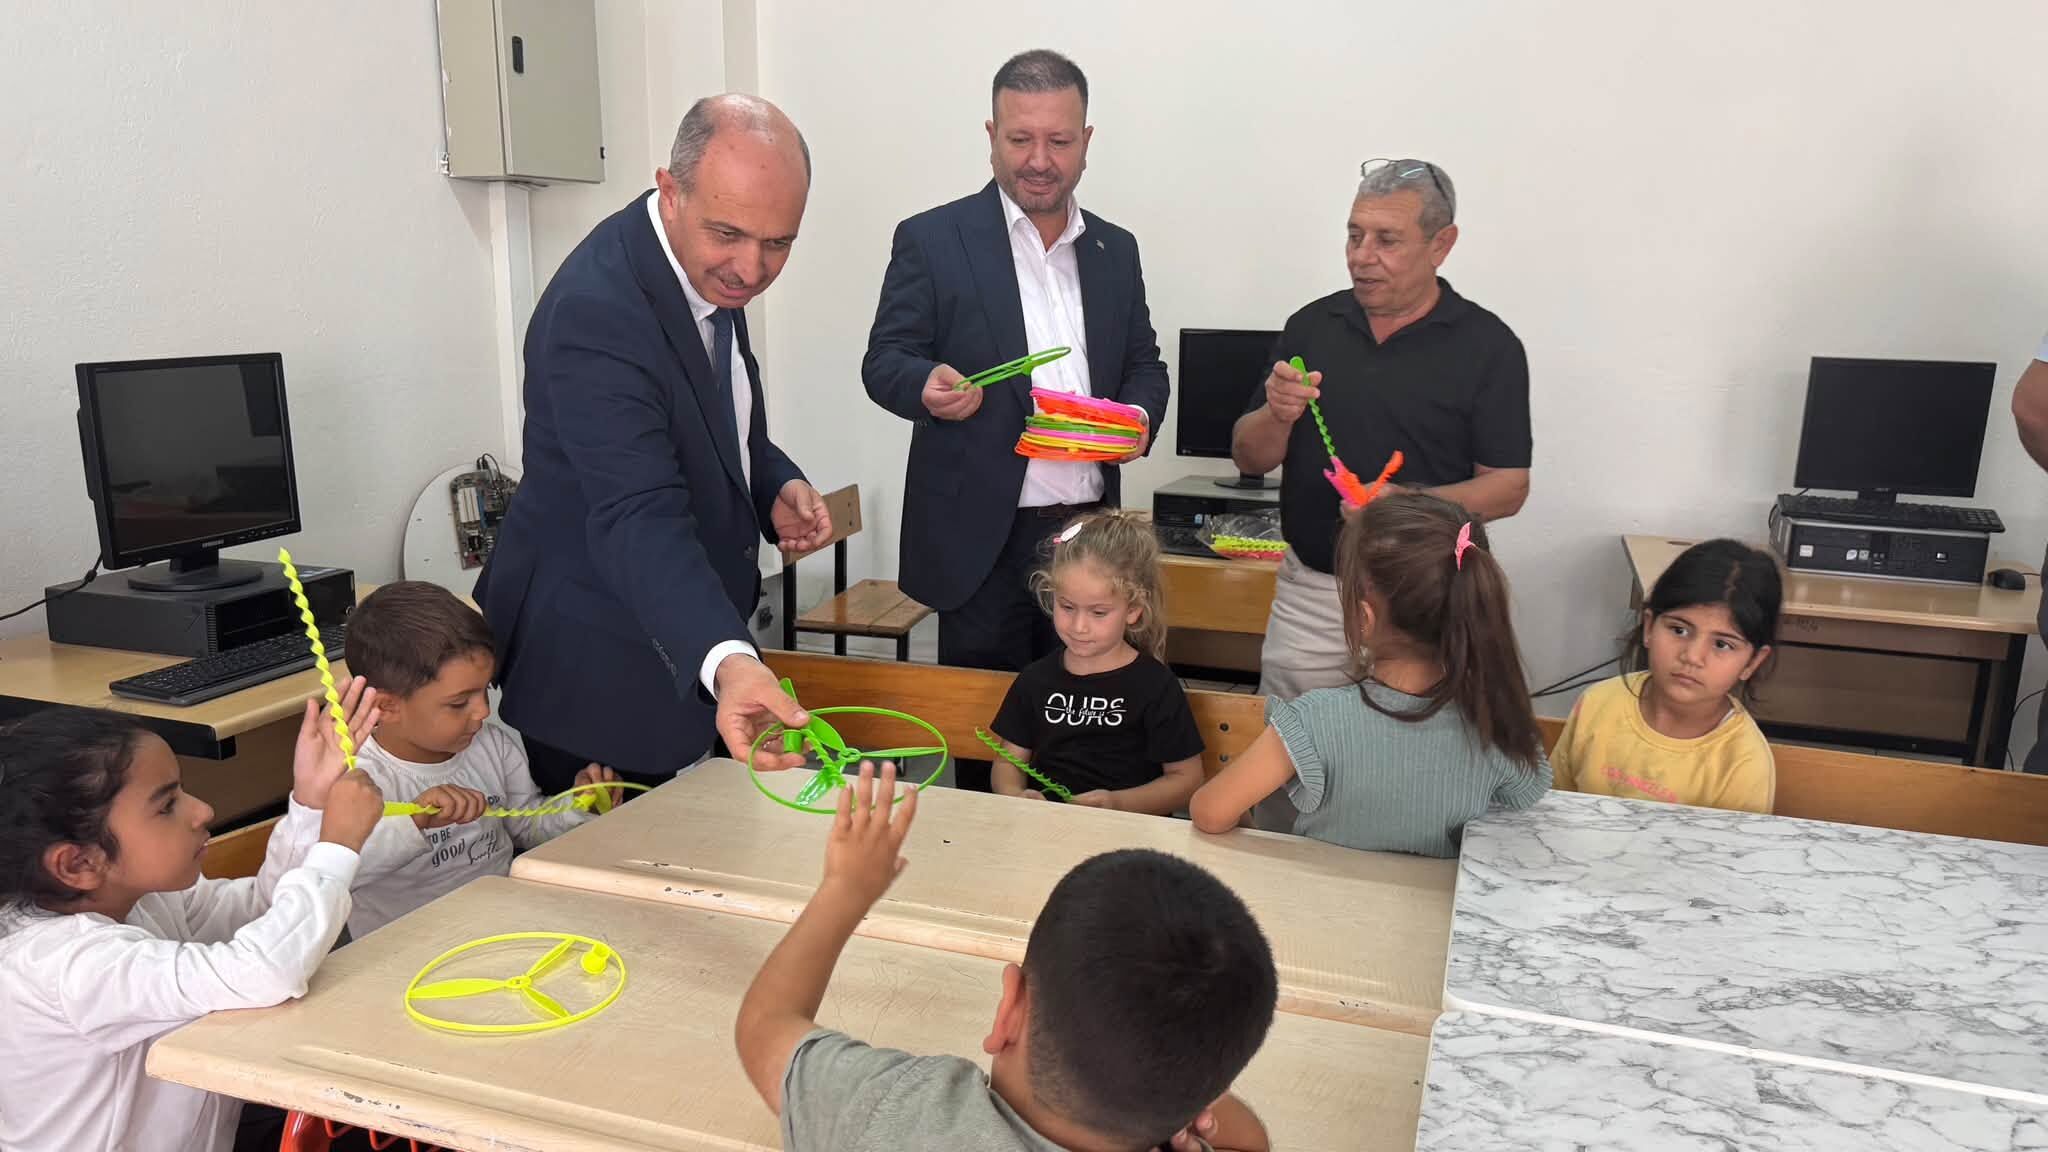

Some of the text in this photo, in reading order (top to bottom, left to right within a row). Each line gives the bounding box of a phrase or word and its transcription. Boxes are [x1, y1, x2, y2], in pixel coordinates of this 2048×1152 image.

[1044, 692, 1124, 726] OURS
[440, 826, 451, 843] BE
[431, 838, 466, 868] good
